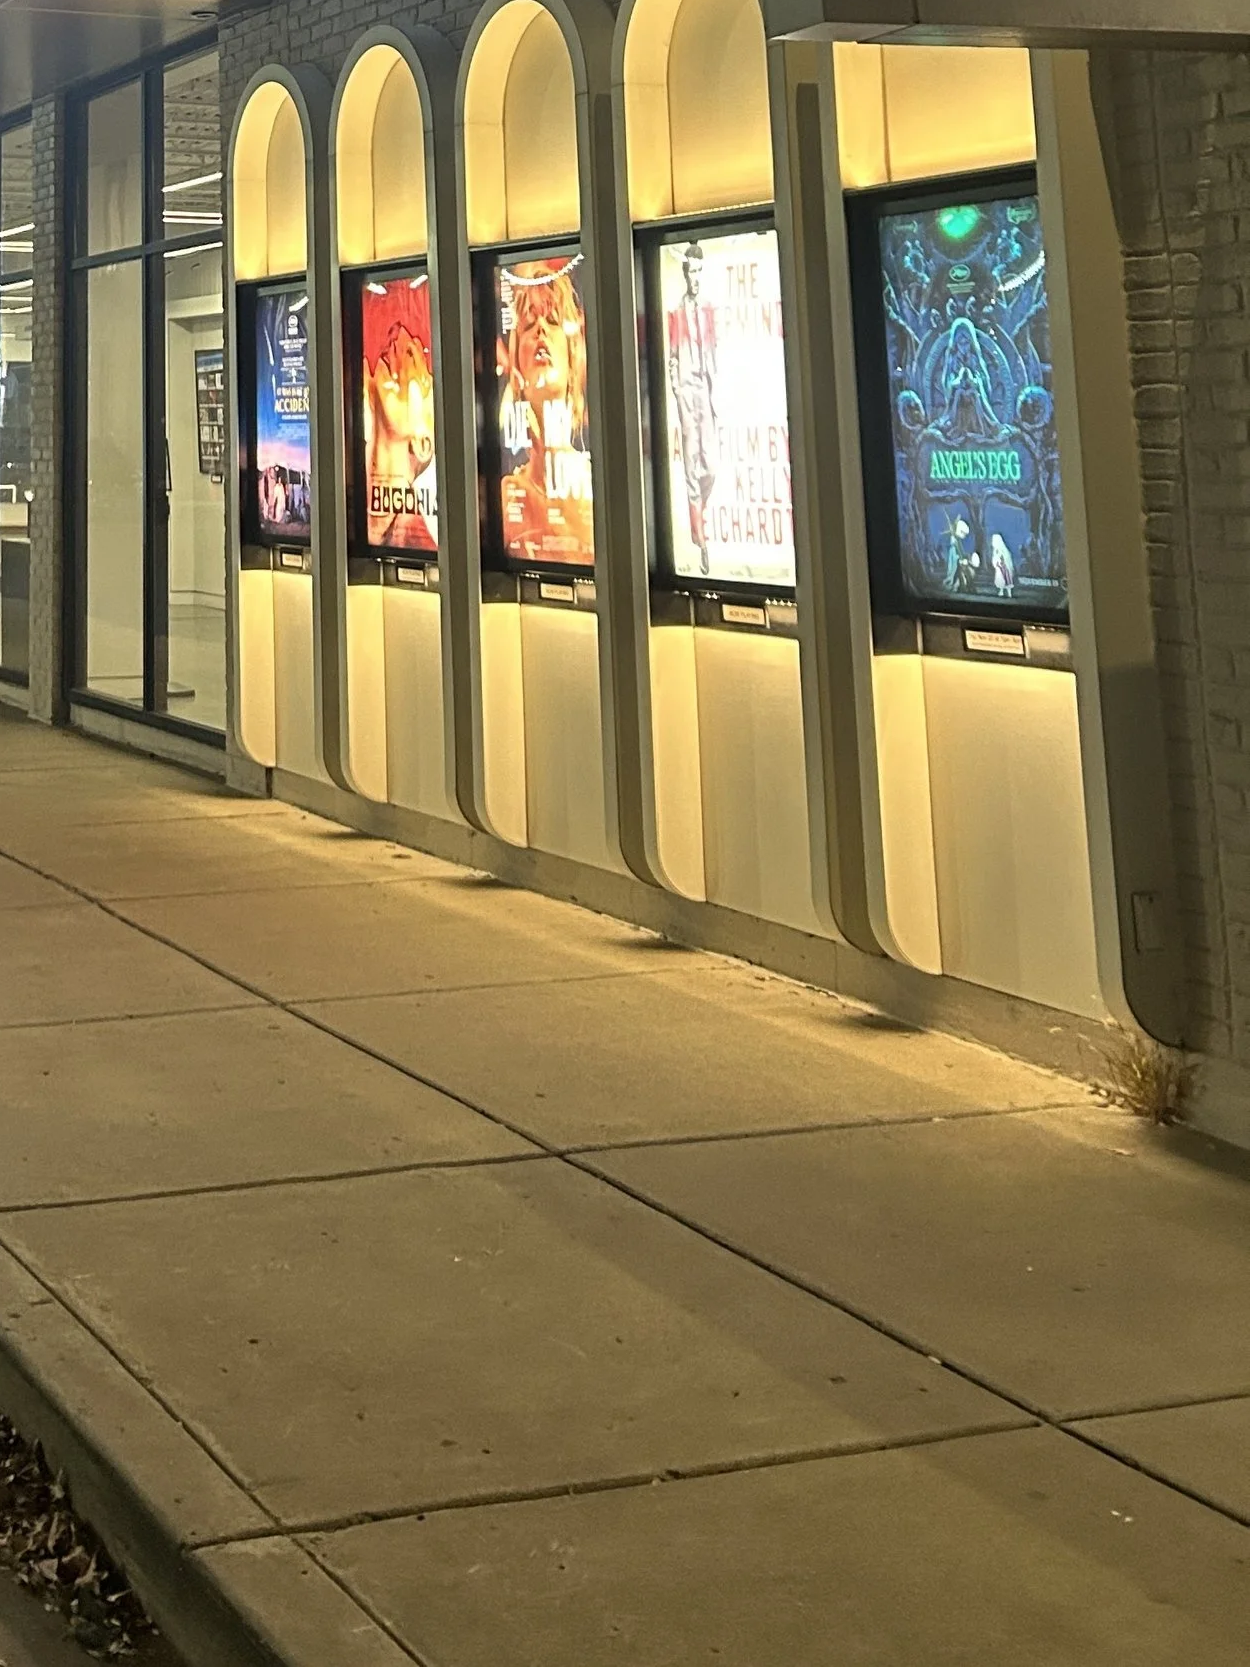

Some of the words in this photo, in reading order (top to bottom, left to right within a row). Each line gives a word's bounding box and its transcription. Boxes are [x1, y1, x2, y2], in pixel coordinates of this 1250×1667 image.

[726, 262, 758, 299] THE
[274, 397, 310, 413] ACCIDEN
[504, 401, 532, 448] DIE
[673, 426, 682, 462] A
[718, 426, 760, 462] FILM
[930, 450, 986, 479] ANGEL'S
[987, 451, 1021, 480] EGG
